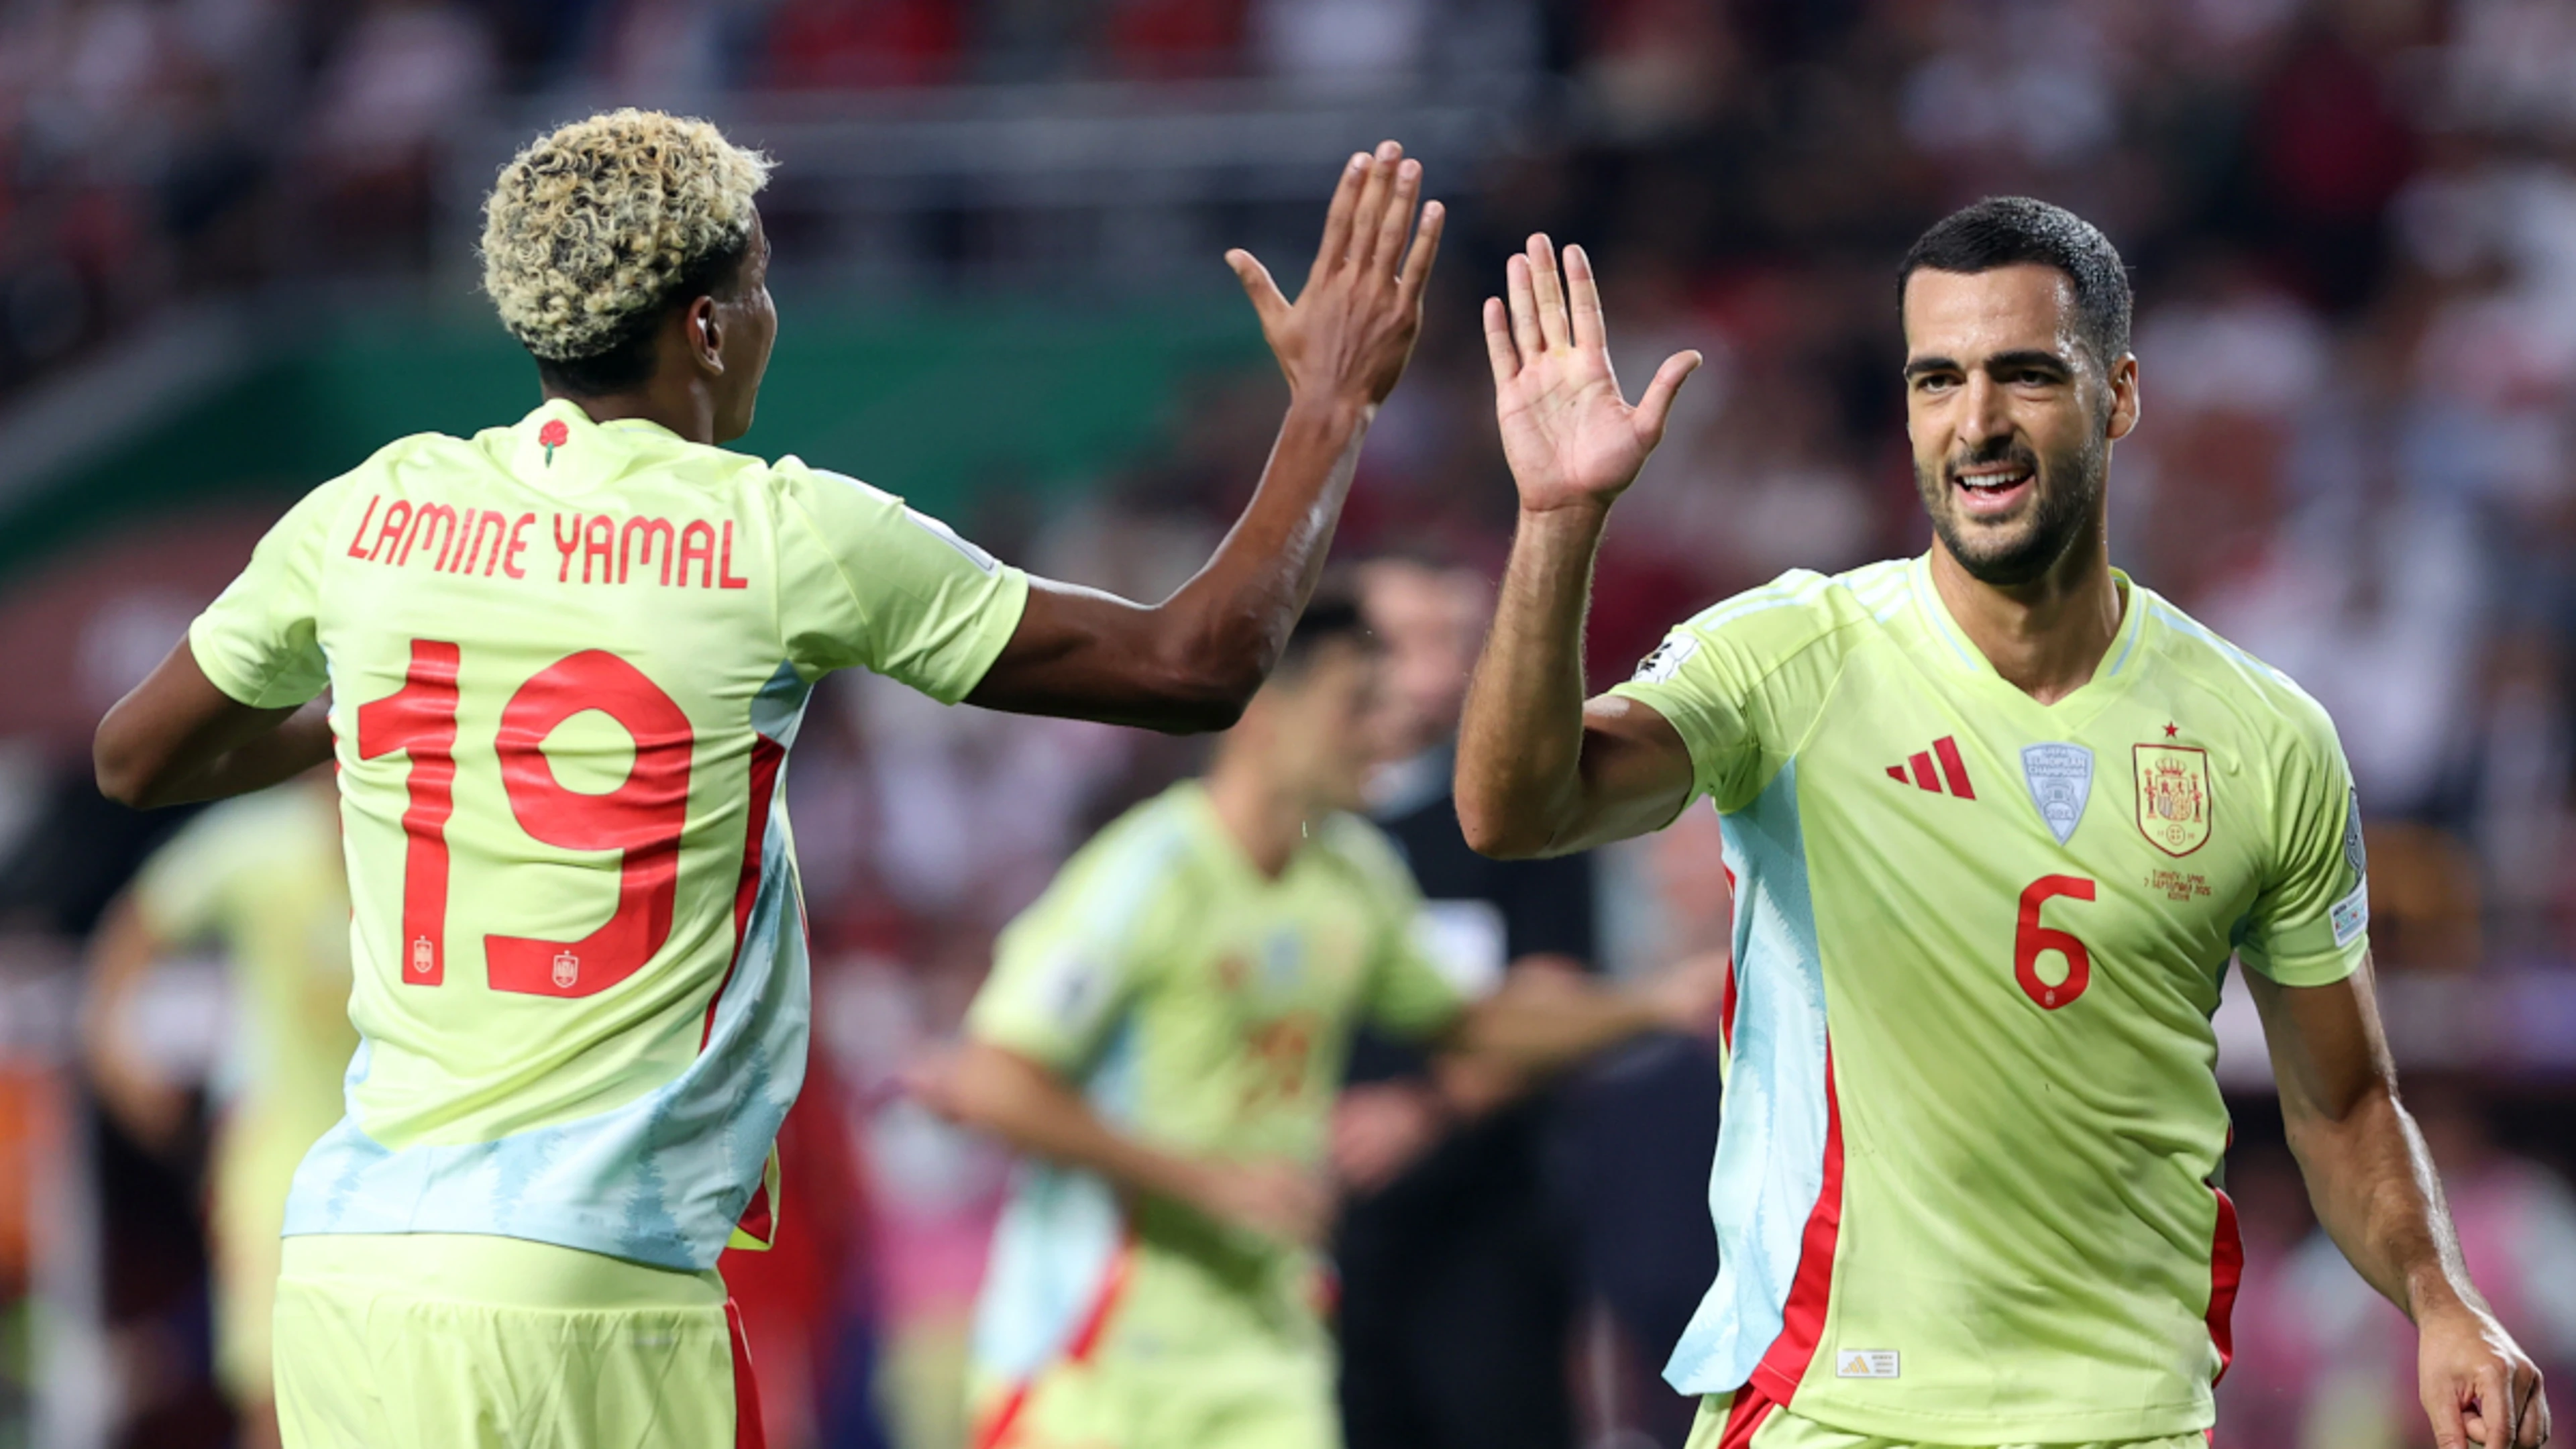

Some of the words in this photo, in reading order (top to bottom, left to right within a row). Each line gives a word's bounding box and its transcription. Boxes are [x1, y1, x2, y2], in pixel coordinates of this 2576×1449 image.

[347, 495, 536, 579] LAMINE
[553, 513, 749, 589] YAMAL
[358, 639, 694, 999] 19
[2015, 874, 2096, 1010] 6
